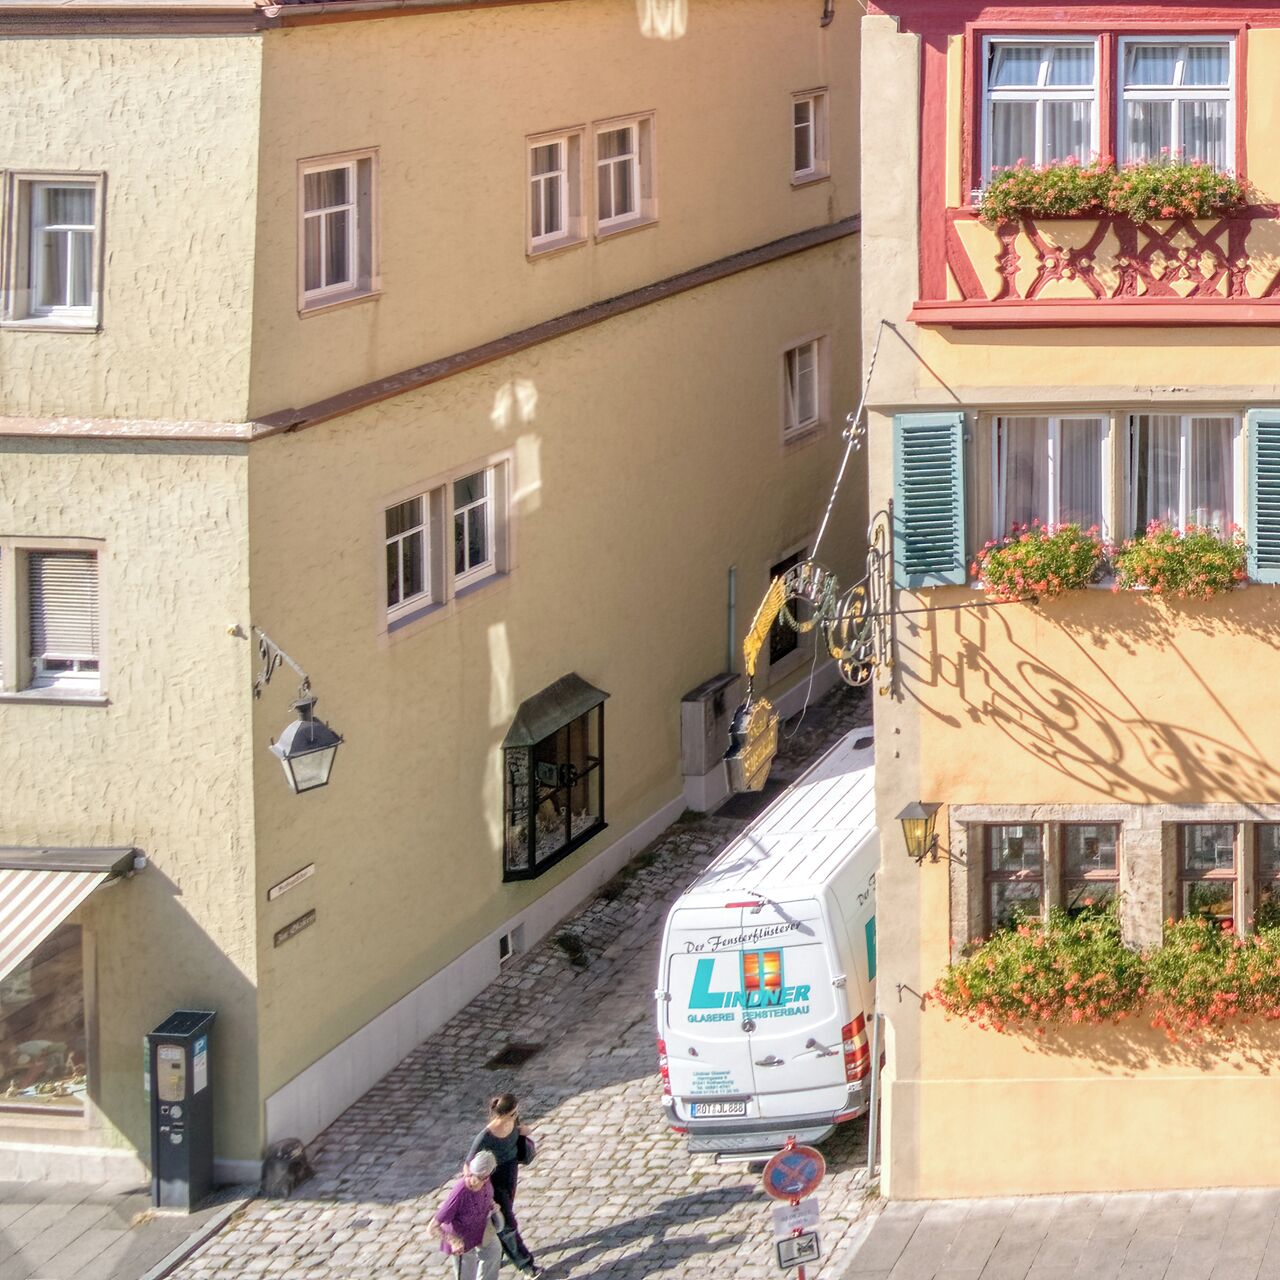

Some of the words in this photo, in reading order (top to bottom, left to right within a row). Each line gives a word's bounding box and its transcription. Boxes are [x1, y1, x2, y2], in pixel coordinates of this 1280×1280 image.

[684, 941, 705, 954] Der
[708, 922, 801, 952] Fensterflüsterer
[688, 1013, 735, 1023] GLASEREI
[742, 1006, 810, 1020] FENSTERBAU
